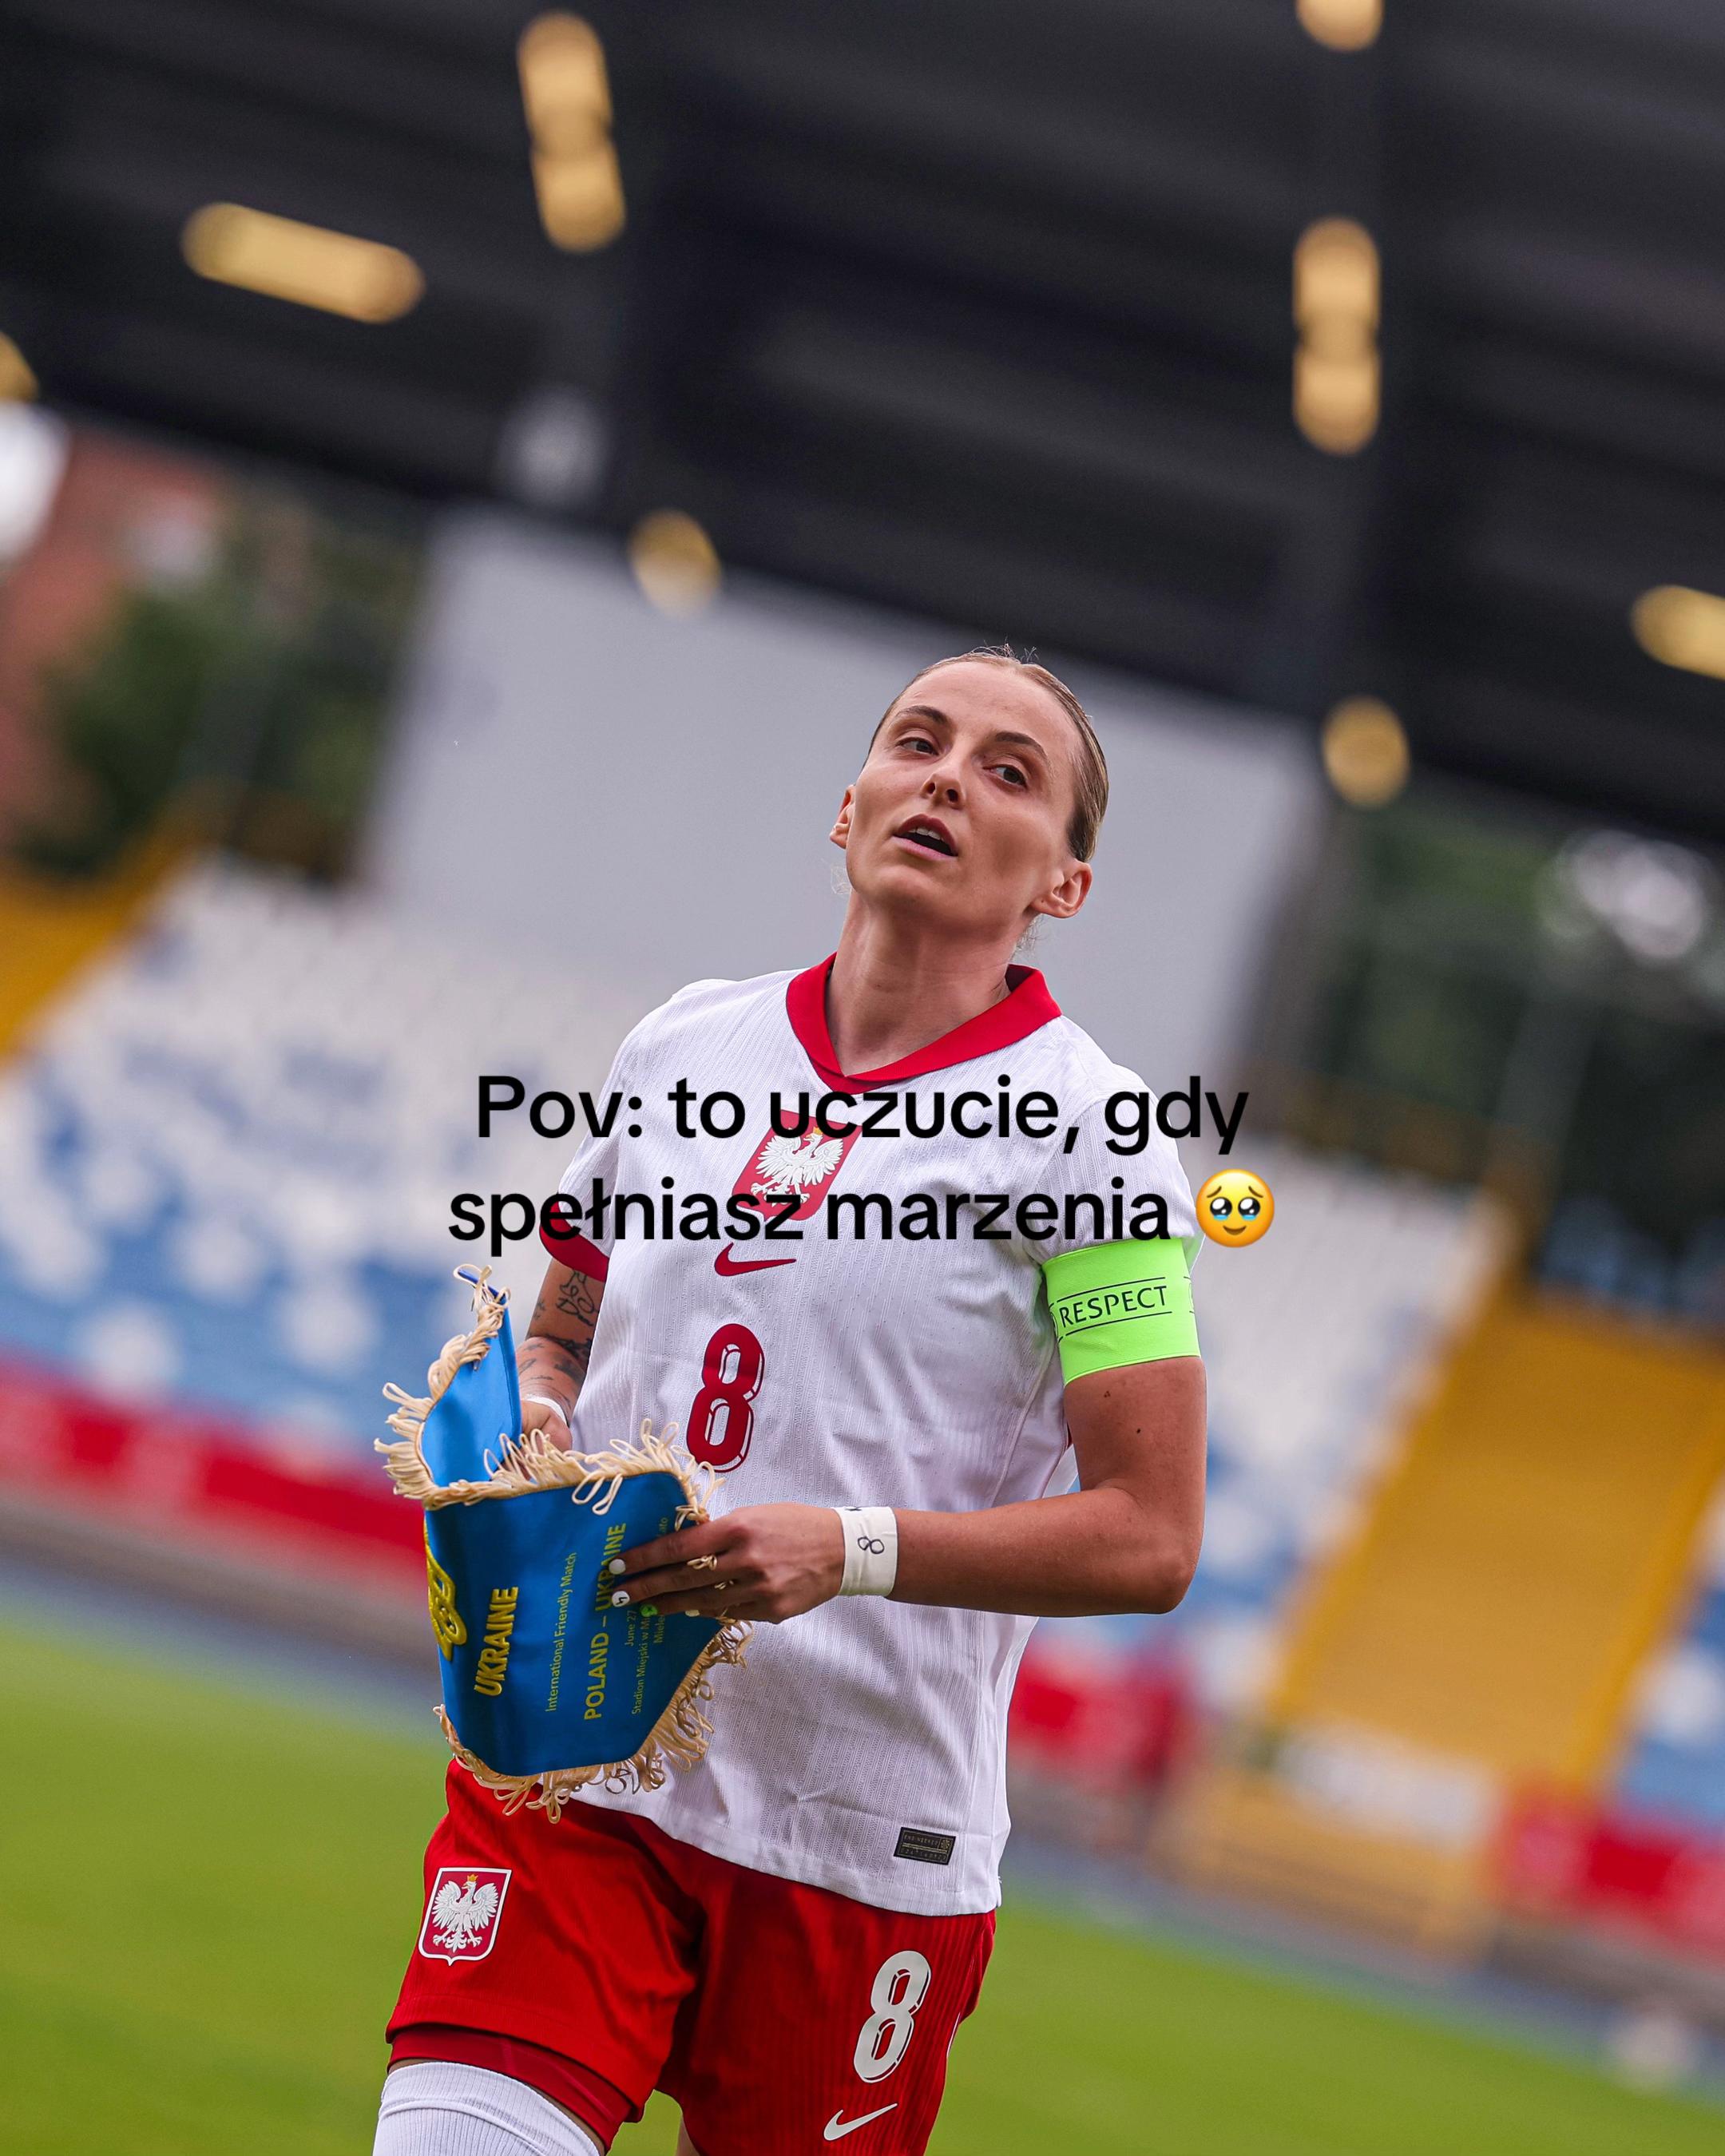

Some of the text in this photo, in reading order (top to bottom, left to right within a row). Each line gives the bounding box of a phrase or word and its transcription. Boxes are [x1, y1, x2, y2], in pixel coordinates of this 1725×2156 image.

[1059, 1285, 1167, 1328] RESPECT
[686, 1323, 765, 1472] 8
[474, 1586, 519, 1697] UKRAINE
[545, 1552, 577, 1712] International Friendly Match
[625, 1623, 636, 1647] June
[636, 1643, 649, 1677] Miejski
[653, 1615, 665, 1644] Miele
[584, 1632, 609, 1720] POLAND
[632, 1678, 644, 1714] Stadion
[853, 1950, 931, 2083] 8
